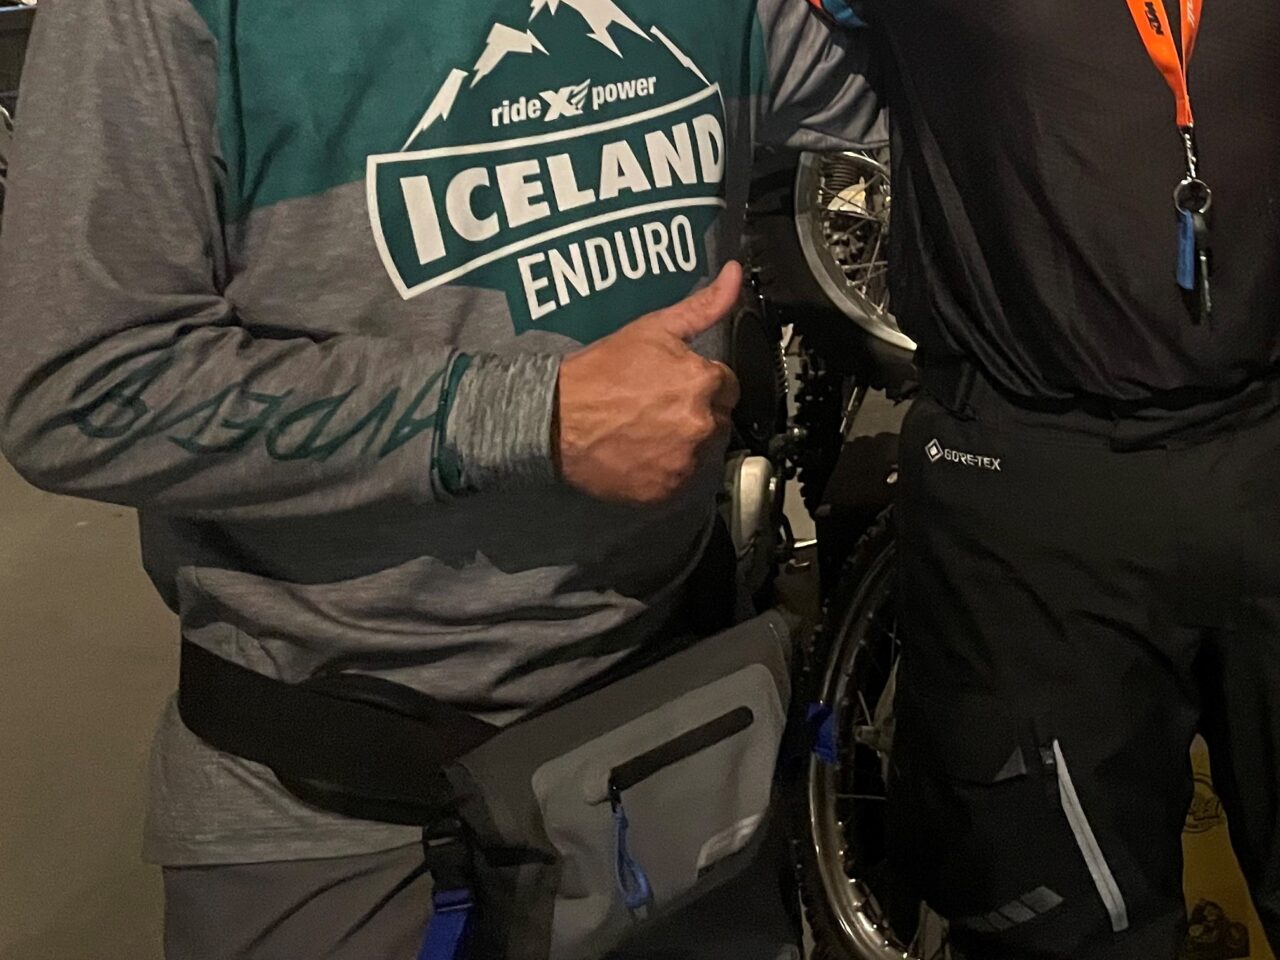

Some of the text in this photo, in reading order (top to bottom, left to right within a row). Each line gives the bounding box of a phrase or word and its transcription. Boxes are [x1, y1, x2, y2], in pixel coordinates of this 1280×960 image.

[491, 96, 542, 127] ride
[591, 75, 657, 111] power
[400, 113, 726, 266] ICELAND
[516, 214, 698, 321] ENDURO
[944, 448, 1001, 471] GORE-TEX
